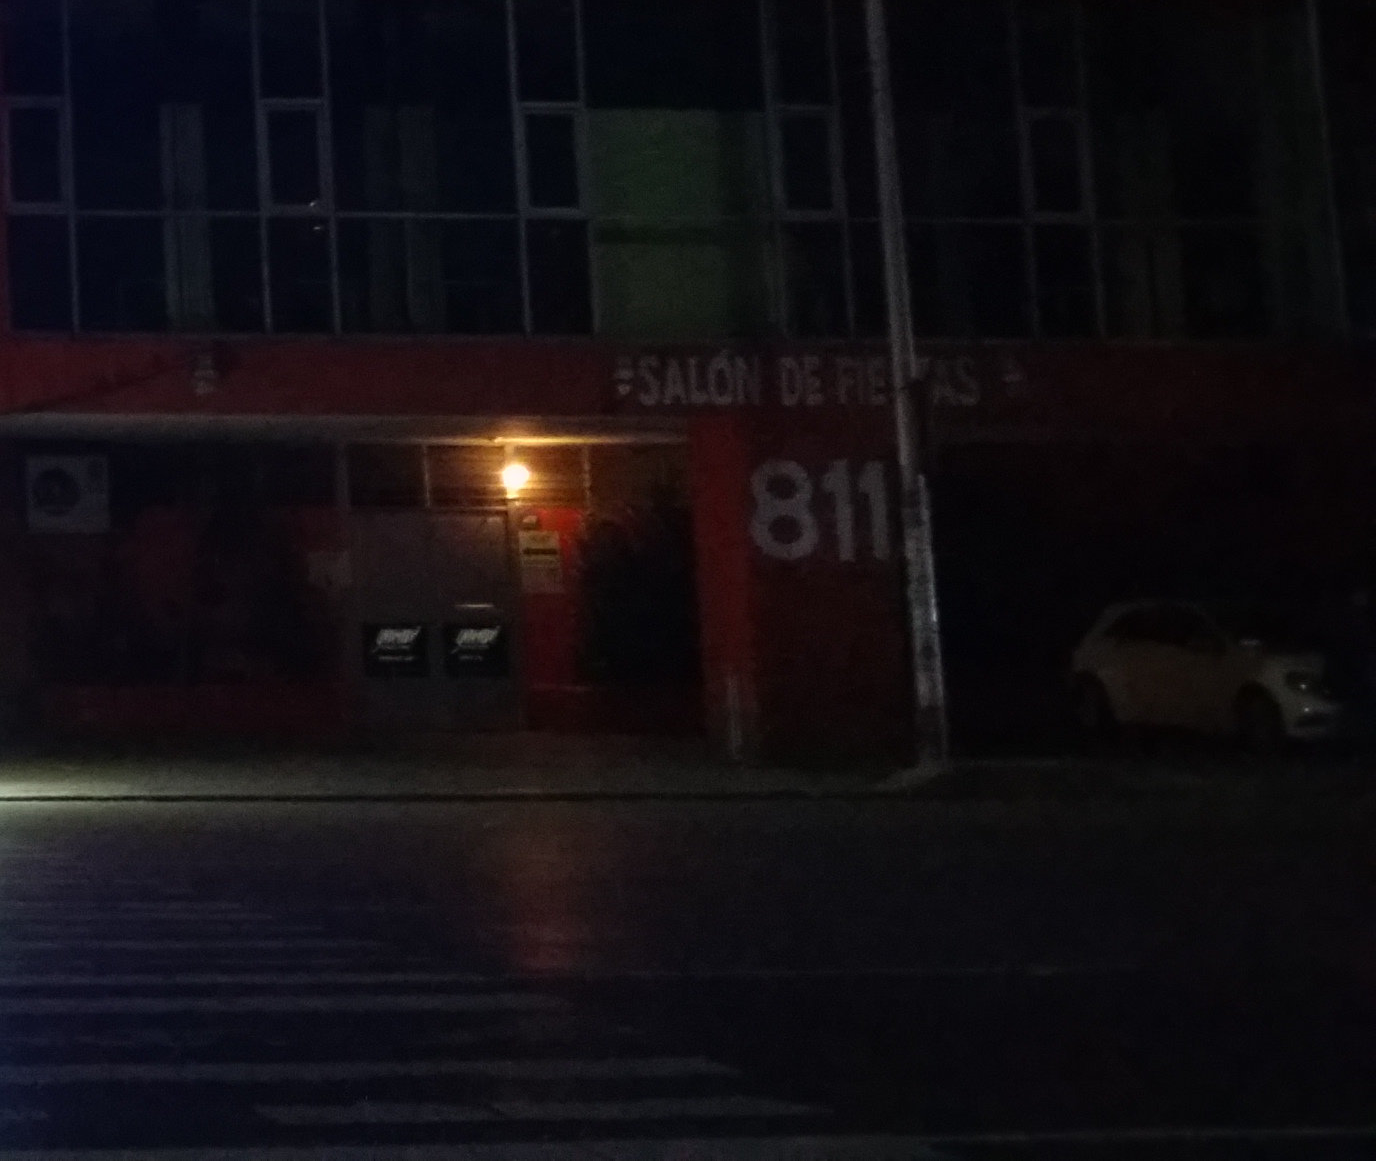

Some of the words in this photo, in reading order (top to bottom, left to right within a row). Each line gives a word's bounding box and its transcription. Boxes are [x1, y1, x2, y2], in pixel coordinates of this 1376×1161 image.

[638, 349, 763, 406] SALÓN
[777, 356, 825, 406] DE
[835, 356, 982, 407] FIEAS
[750, 457, 891, 564] 811
